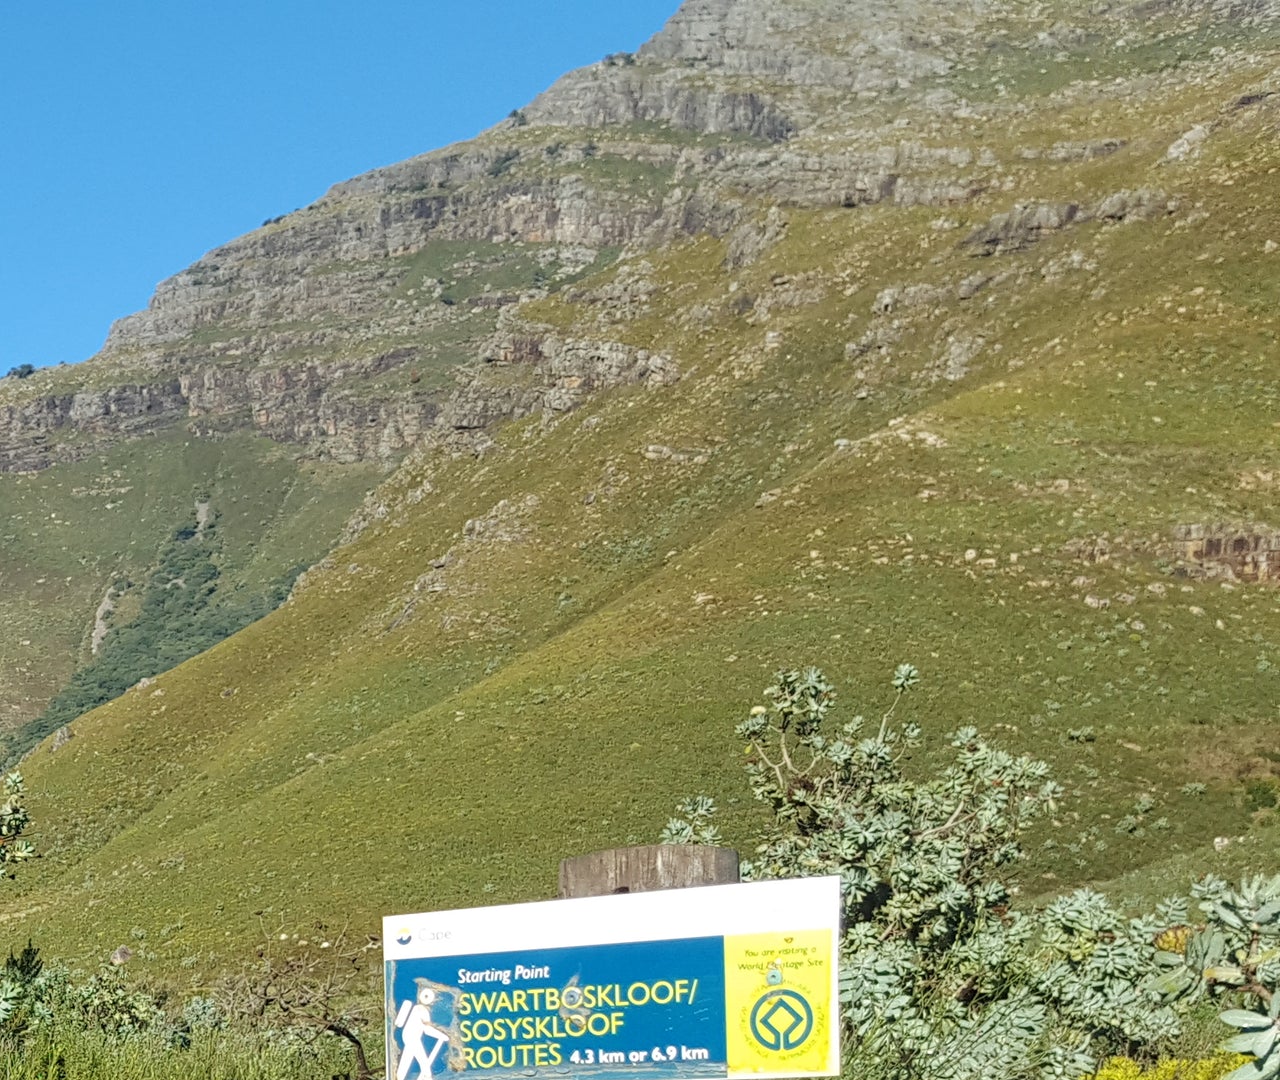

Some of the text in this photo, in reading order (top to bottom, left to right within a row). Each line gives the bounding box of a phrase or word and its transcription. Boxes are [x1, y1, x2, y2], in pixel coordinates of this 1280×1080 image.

[738, 961, 764, 971] World
[807, 959, 824, 967] Site
[744, 949, 759, 958] You
[457, 964, 550, 985] Starting Point
[459, 979, 698, 1016] SWARTBOSKLOOF/
[460, 1012, 624, 1042] SOSYSKLOOF
[461, 1043, 709, 1069] ROUTES 4.3 km or 6.9 km
